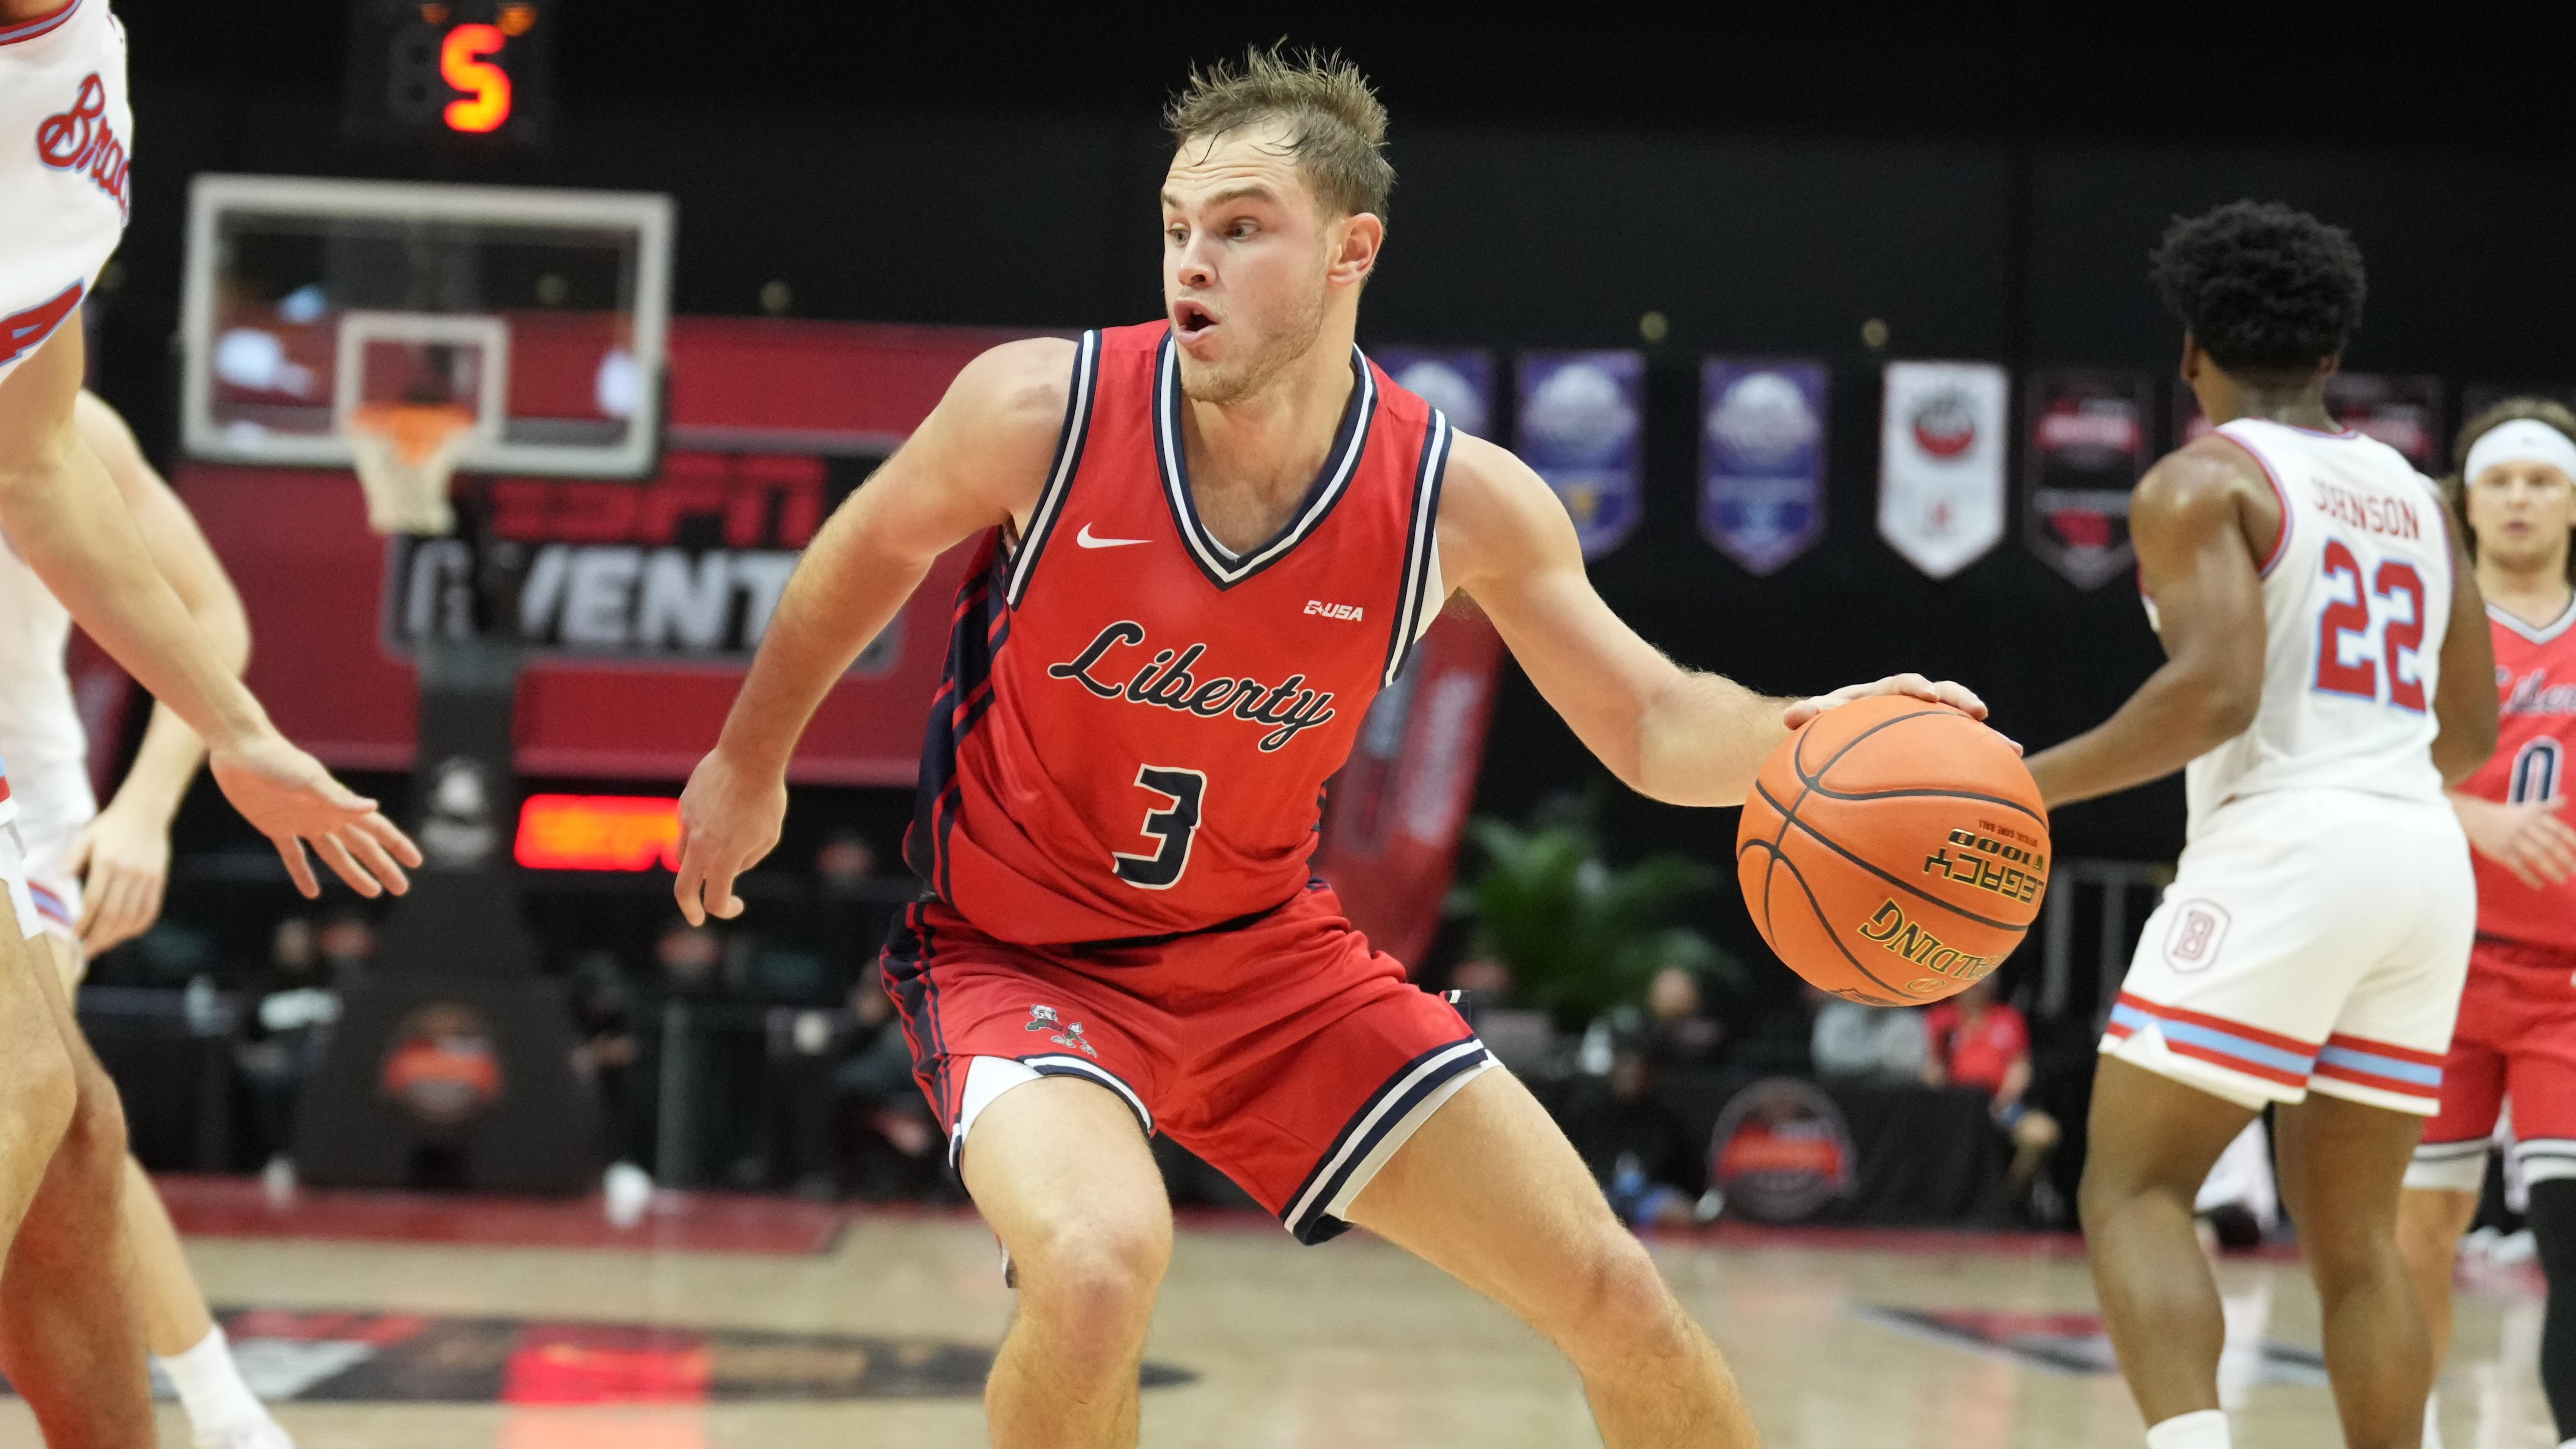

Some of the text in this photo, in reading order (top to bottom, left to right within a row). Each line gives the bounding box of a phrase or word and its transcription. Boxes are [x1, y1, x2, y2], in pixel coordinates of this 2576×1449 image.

[440, 23, 512, 133] 5
[2311, 476, 2420, 540] JOHNSON
[2311, 534, 2428, 715] 22
[1047, 620, 1335, 753] Liberty
[1112, 763, 1207, 890] 3
[1856, 897, 2001, 980] PALDING
